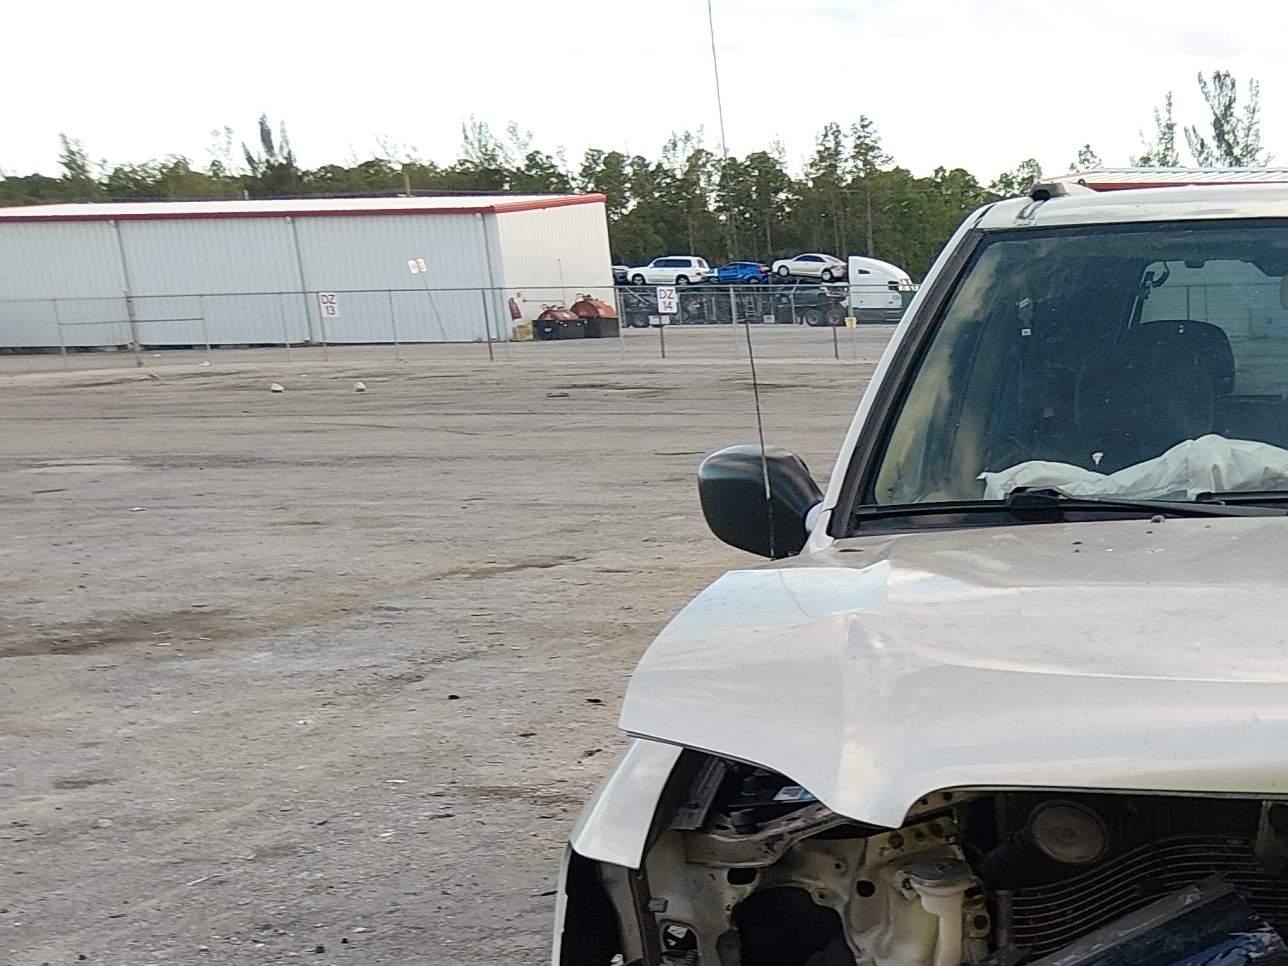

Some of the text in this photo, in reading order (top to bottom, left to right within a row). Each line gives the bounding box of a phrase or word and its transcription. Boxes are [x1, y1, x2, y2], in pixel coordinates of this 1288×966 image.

[320, 294, 336, 305] DZ
[659, 288, 674, 300] DZ
[325, 305, 336, 315] 13
[663, 300, 673, 311] 14
